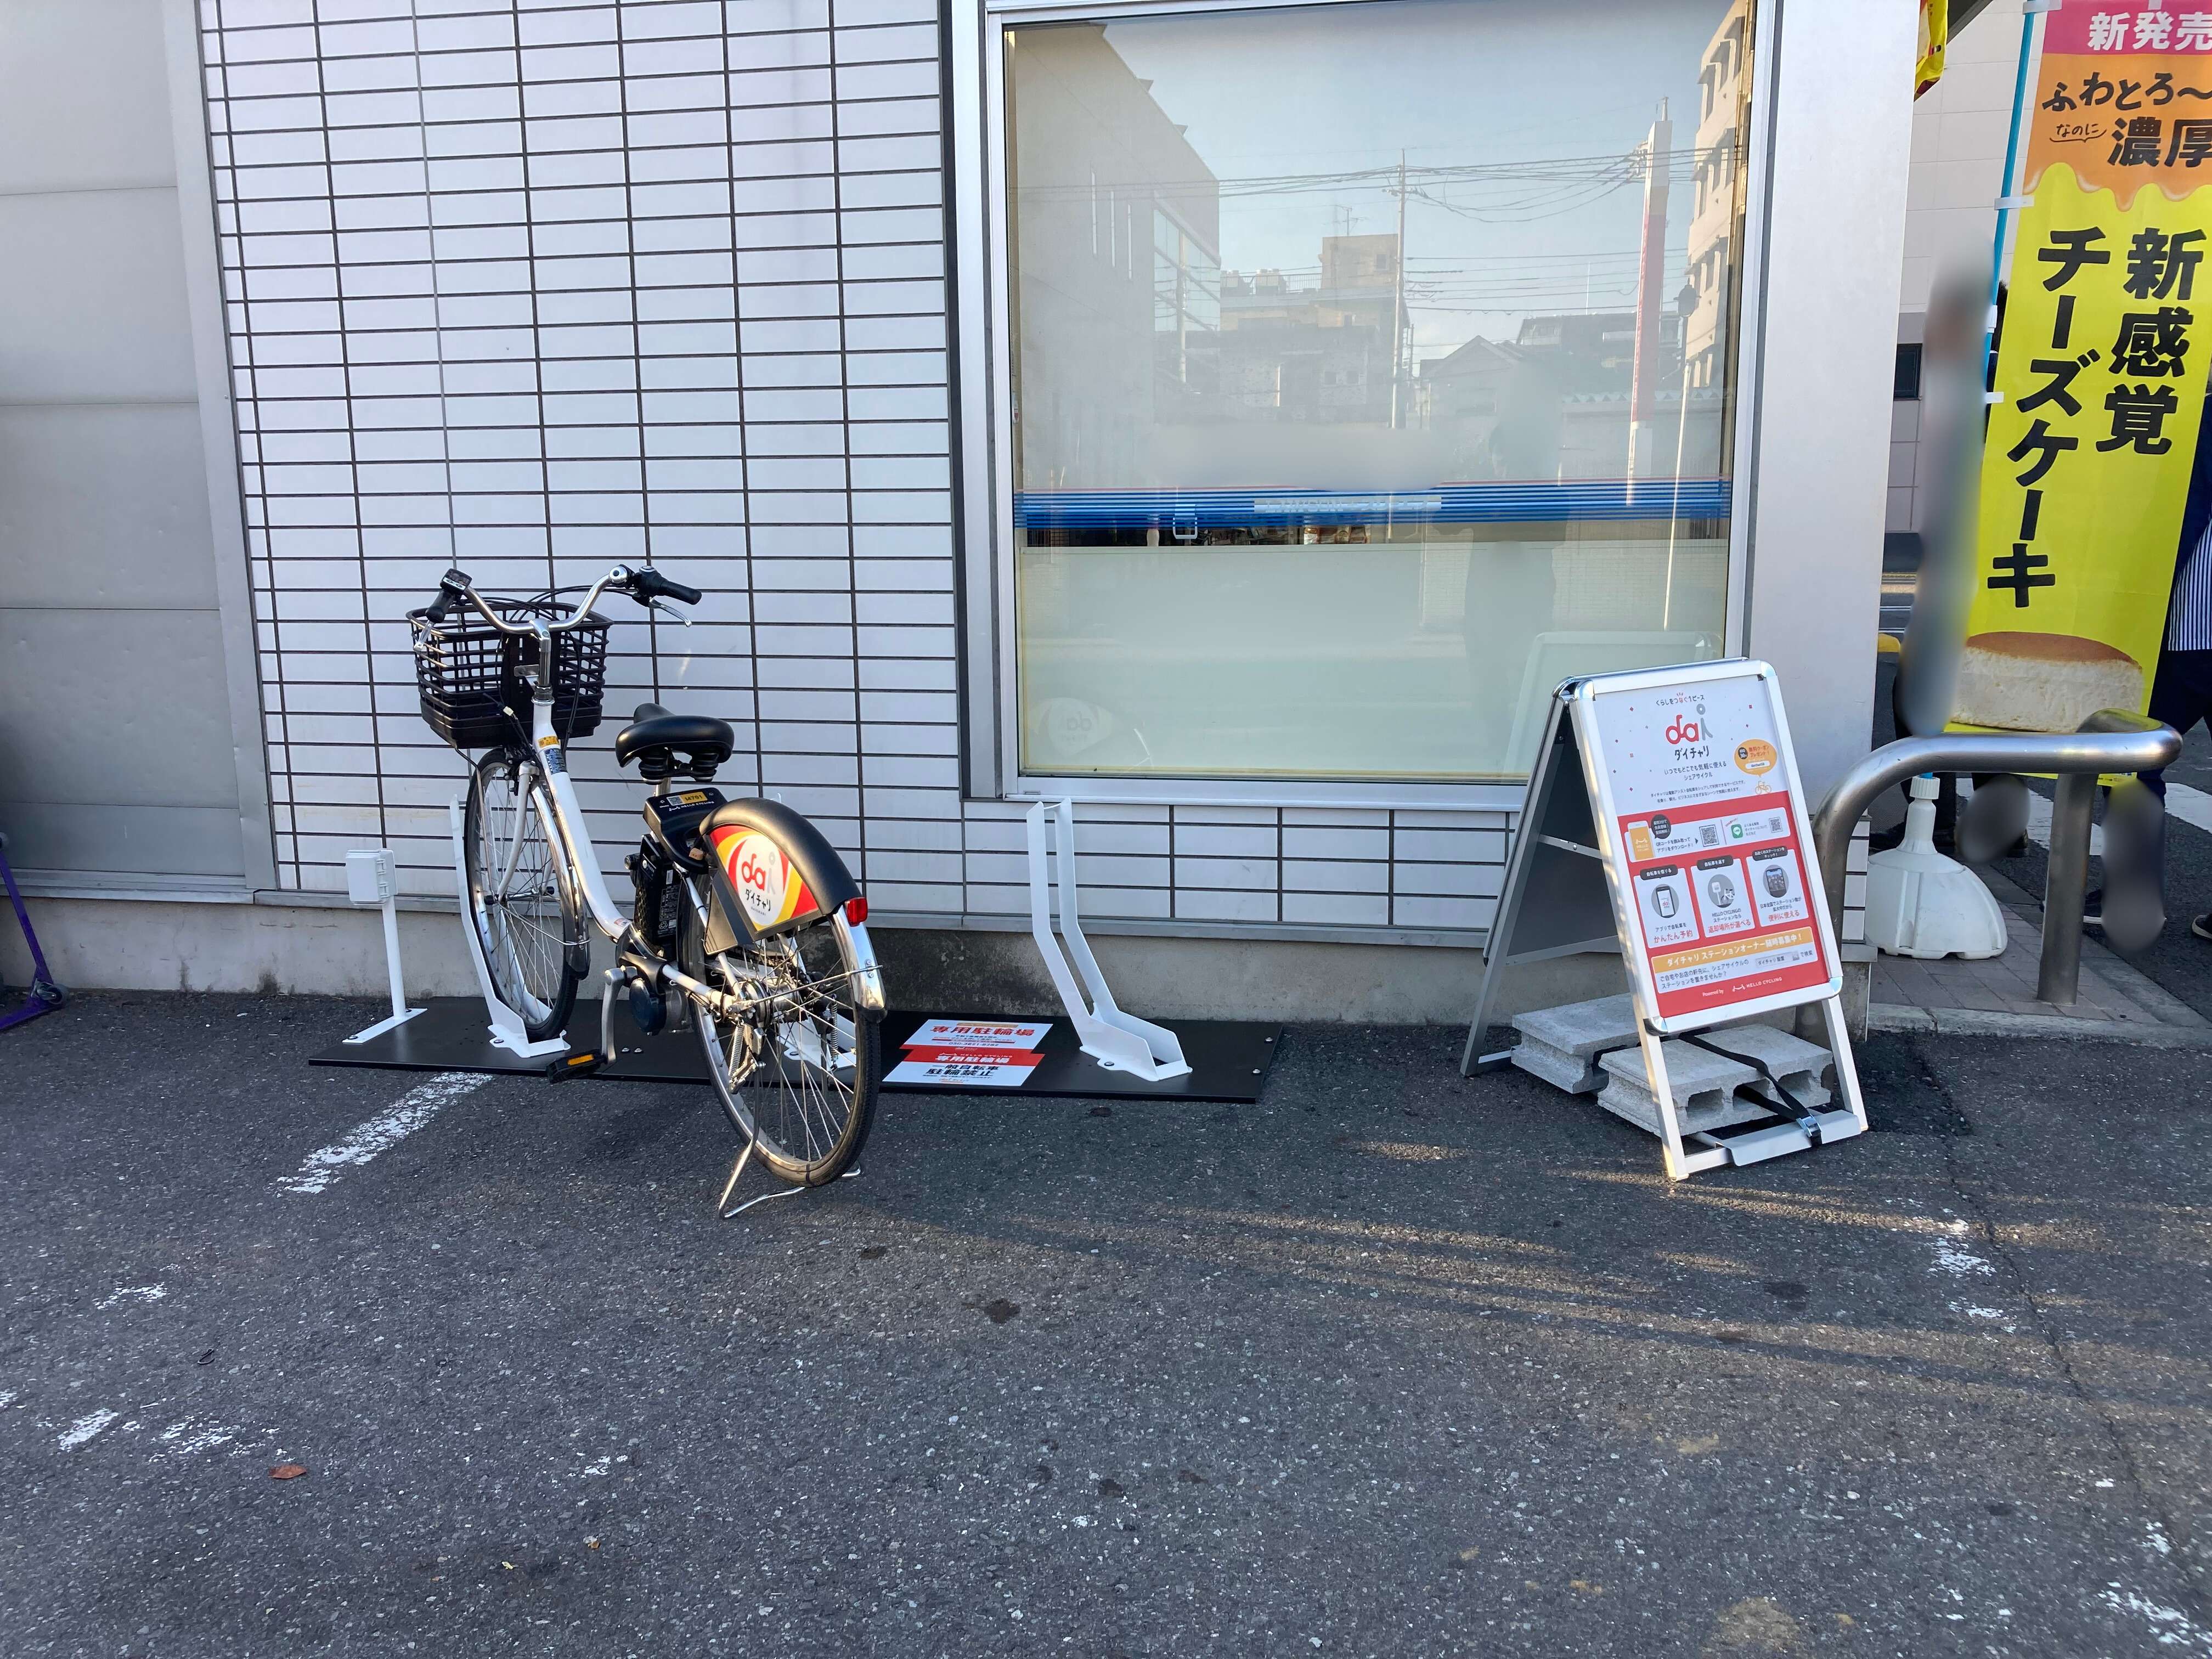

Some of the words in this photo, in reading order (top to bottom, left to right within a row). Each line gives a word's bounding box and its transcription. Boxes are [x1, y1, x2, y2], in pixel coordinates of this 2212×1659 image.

[2088, 12, 2212, 50] 新発売
[2057, 123, 2099, 138] なのに
[2107, 116, 2212, 168] 濃厚
[2096, 228, 2207, 455] 新感覚
[1987, 227, 2110, 608] チーズケーキ
[1666, 703, 1713, 744] dai
[1674, 746, 1709, 761] ダイチャリ
[1664, 761, 1726, 775] いつでもどこでも気軽に使える
[1684, 772, 1713, 781] シェアサイクル
[1656, 837, 1690, 847] QRコードを読み取って
[742, 851, 776, 895] dai
[746, 889, 771, 911] ダイチャリ
[1713, 913, 1741, 923] ステーションなら
[1768, 910, 1799, 922] 便利に使える
[1655, 922, 1687, 932] アプリで自転車を
[1708, 919, 1751, 933] 返却場所が選べる
[1654, 929, 1693, 943] かんたん予約
[1667, 953, 1699, 967] ダイチャリ
[1662, 971, 1726, 989] ステーションを置きませんか？
[930, 1026, 1035, 1036] 専用駐輪場
[925, 1068, 994, 1076] 駐輪禁止
